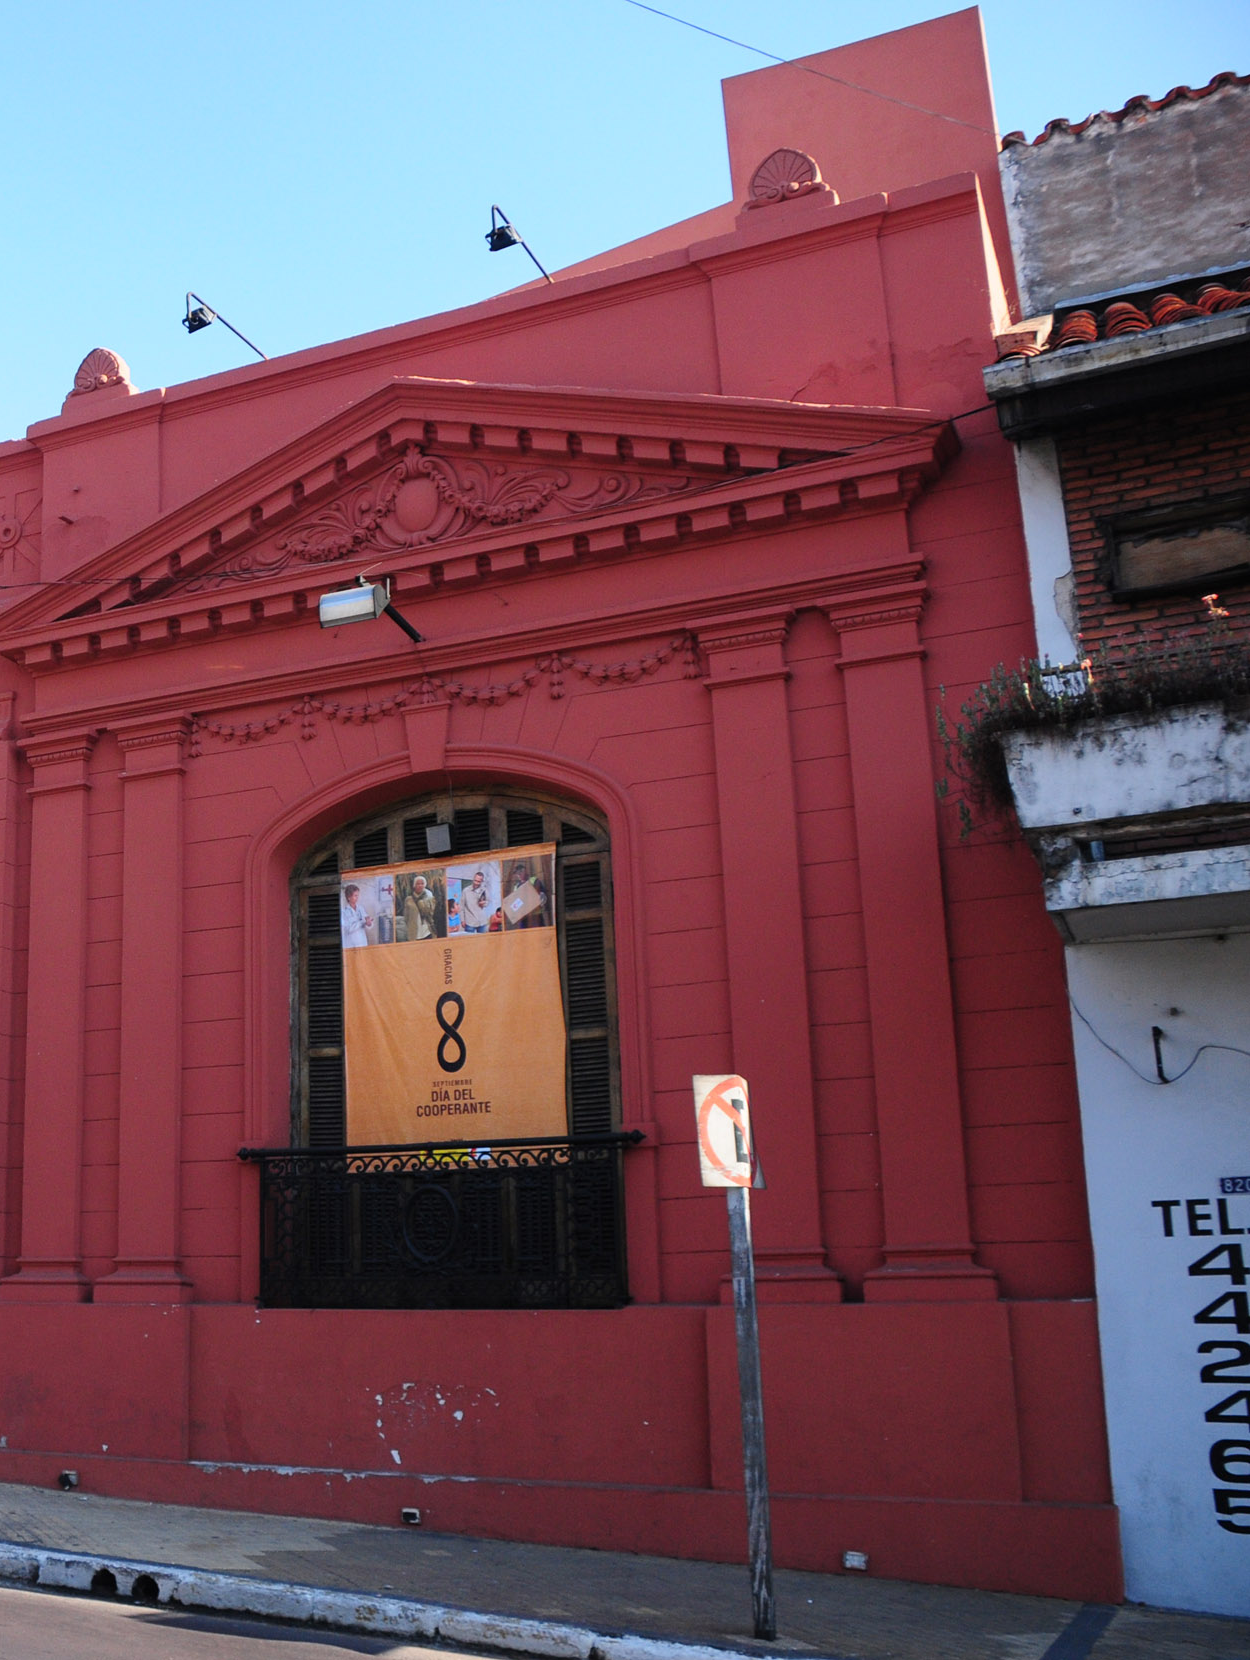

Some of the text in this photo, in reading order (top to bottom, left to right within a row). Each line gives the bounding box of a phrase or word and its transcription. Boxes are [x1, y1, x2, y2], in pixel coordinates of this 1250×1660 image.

[443, 948, 453, 985] GRACIAS
[436, 991, 466, 1073] 8
[432, 1079, 472, 1087] SEPTIEMBRE
[431, 1088, 475, 1102] DÍA DEL
[416, 1101, 491, 1117] COOPERANTE
